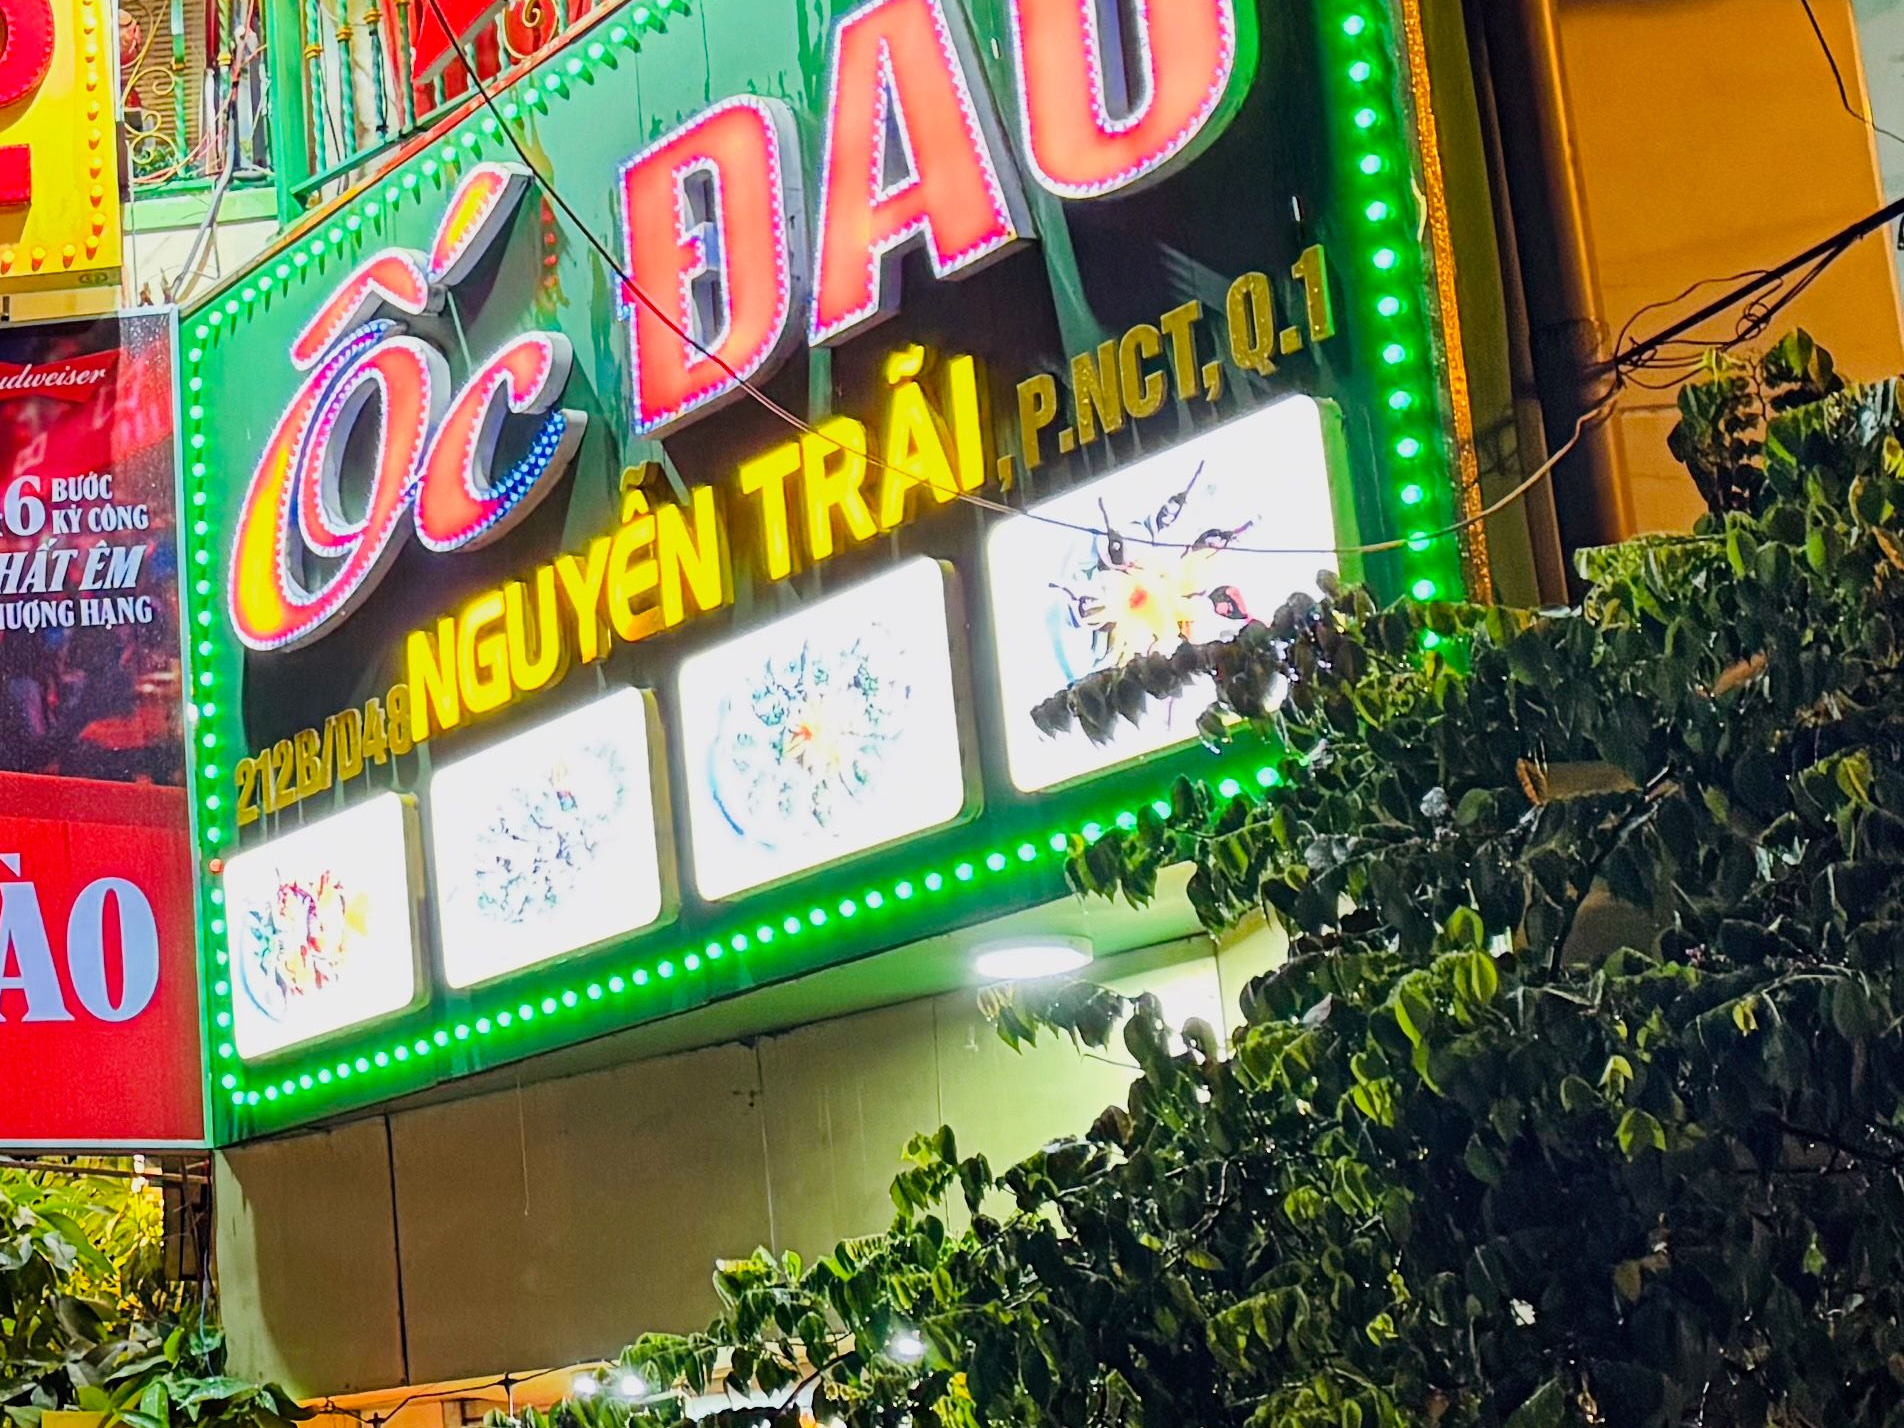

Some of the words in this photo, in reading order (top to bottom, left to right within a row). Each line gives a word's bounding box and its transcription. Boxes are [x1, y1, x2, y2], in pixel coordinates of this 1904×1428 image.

[51, 469, 113, 503] BƯỚC
[88, 502, 149, 533] CÔNG
[78, 539, 148, 592] ÊM
[79, 595, 153, 630] HẠNG
[403, 460, 733, 742] NGUYỄN
